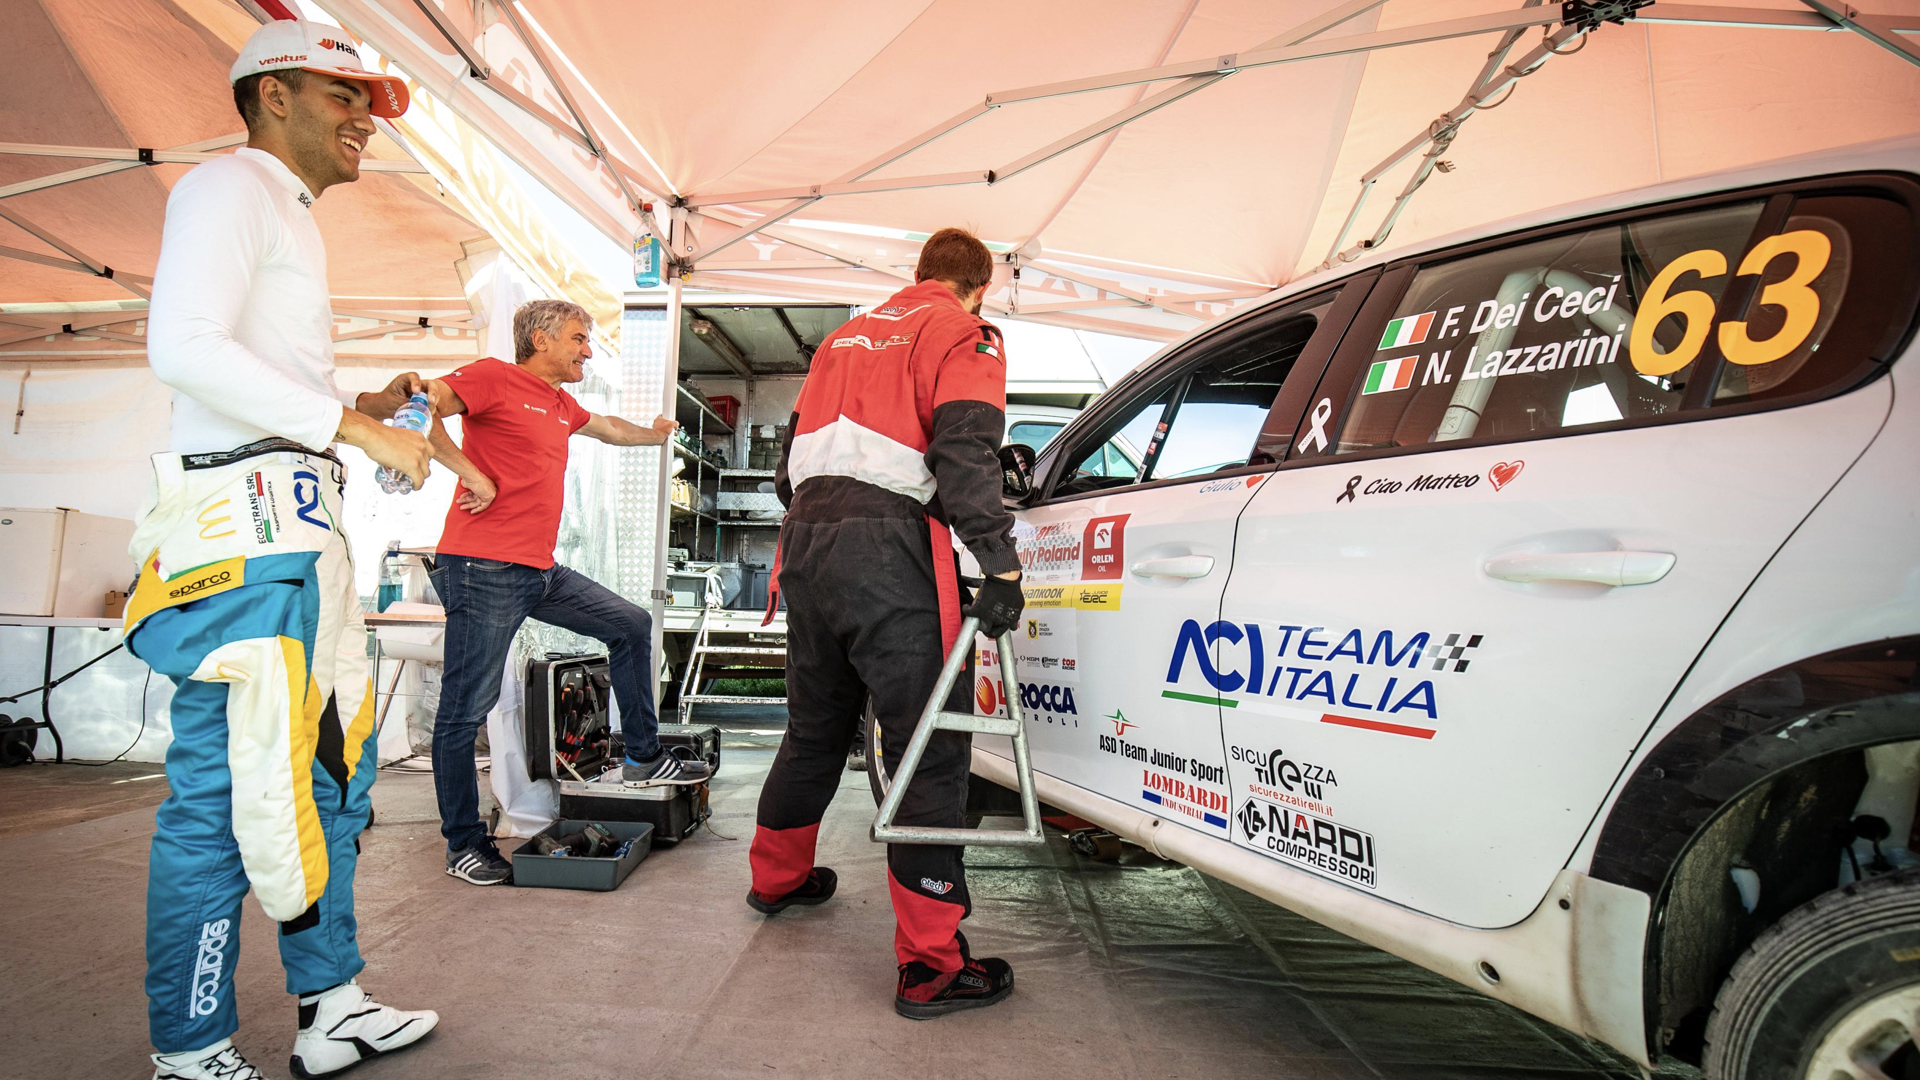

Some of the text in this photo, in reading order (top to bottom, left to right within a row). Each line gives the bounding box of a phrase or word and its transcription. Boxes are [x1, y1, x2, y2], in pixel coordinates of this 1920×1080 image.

[1437, 275, 1622, 340] F. Dei Ceci
[1628, 229, 1832, 376] 63
[1420, 349, 1453, 387] N.
[1460, 324, 1626, 381] Lazzarini
[245, 471, 267, 545] ECOLTRANS SRL
[292, 470, 332, 532] ACI
[1199, 479, 1242, 494] Giulio
[1363, 472, 1480, 496] Ciao Matteo
[1036, 541, 1081, 564] Poland
[1091, 554, 1114, 564] ORLEN
[1097, 565, 1107, 573] OIL
[168, 570, 232, 599] sparco
[1165, 618, 1431, 695] ACI TEAM
[1266, 665, 1438, 720] ITALIA
[1099, 734, 1225, 785] ASD Team Junior Sport
[1142, 769, 1228, 814] LOMBARDI
[1161, 796, 1204, 822] INDUSTRIAL
[1248, 782, 1334, 818] sicurezzatirelli.it
[1266, 835, 1375, 886] COMPRESSORI
[1268, 805, 1375, 868] NARDI
[190, 918, 231, 1019] sparco
